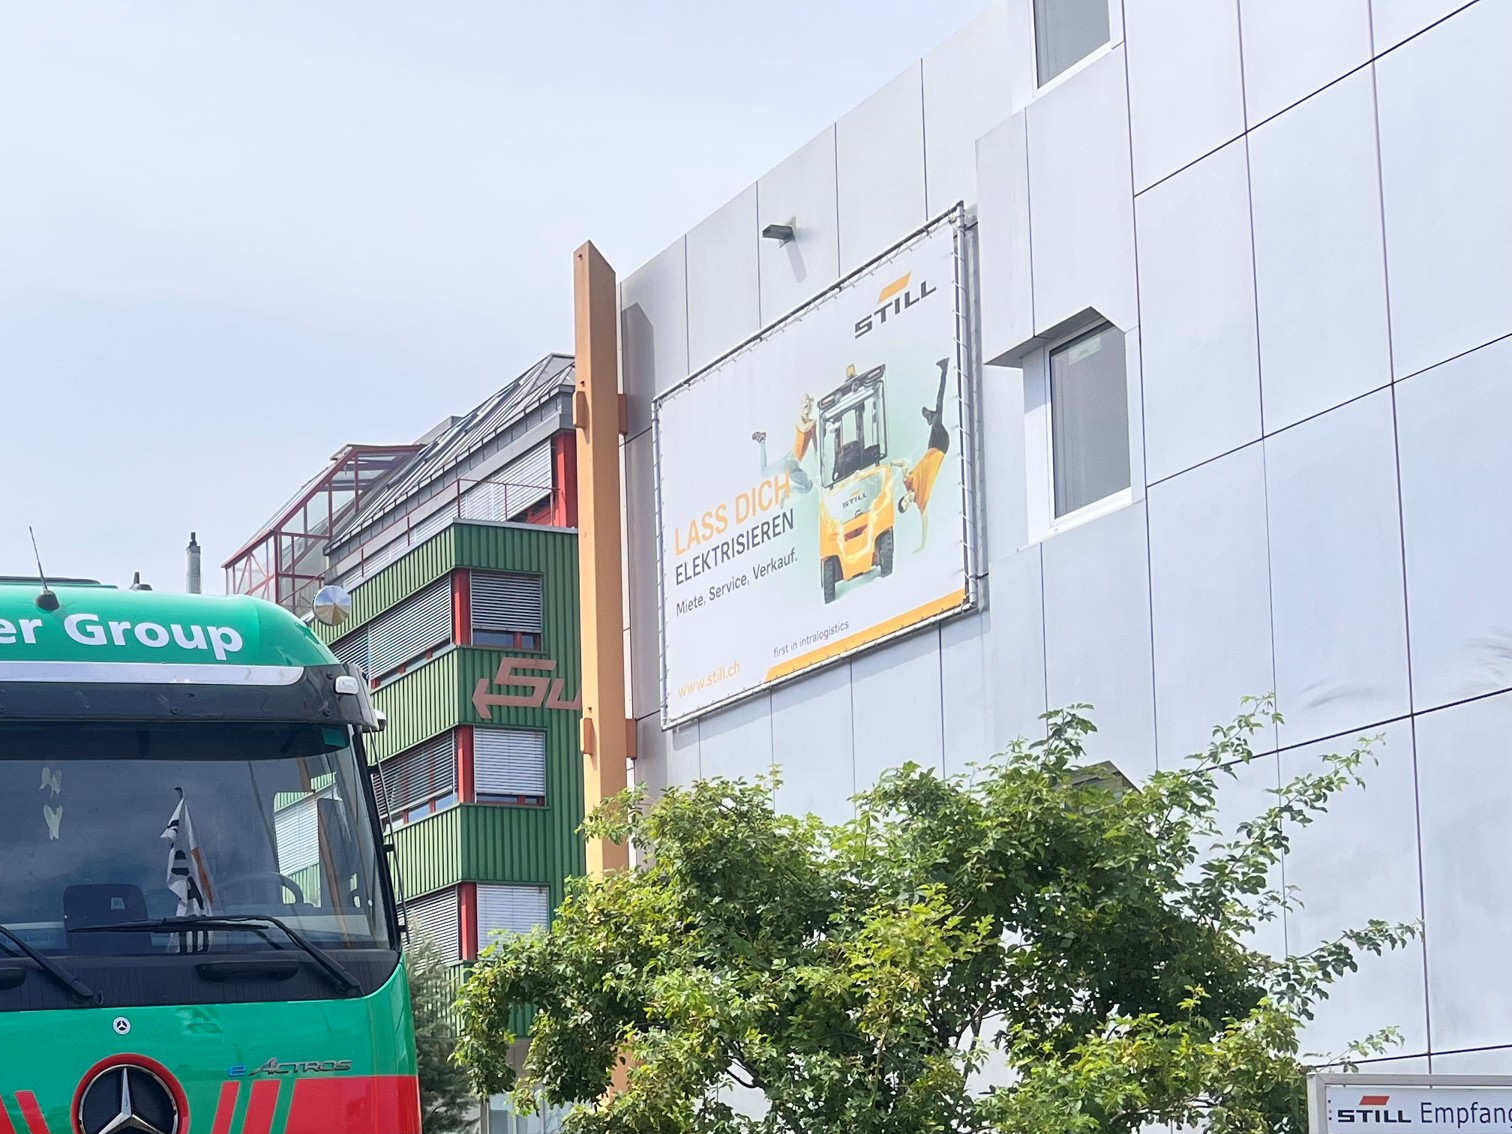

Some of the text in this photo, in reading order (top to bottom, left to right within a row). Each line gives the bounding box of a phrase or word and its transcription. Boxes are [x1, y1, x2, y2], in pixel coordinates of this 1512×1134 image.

[854, 280, 937, 339] STILL
[675, 469, 791, 556] LASS DICH
[675, 508, 795, 586] ELEKTRISIEREN
[676, 547, 798, 617] Miete, Service, Verkauf.
[64, 613, 244, 660] Group
[799, 620, 849, 647] intralogistics
[677, 661, 741, 698] www.still.ch
[1338, 1109, 1412, 1123] STILL
